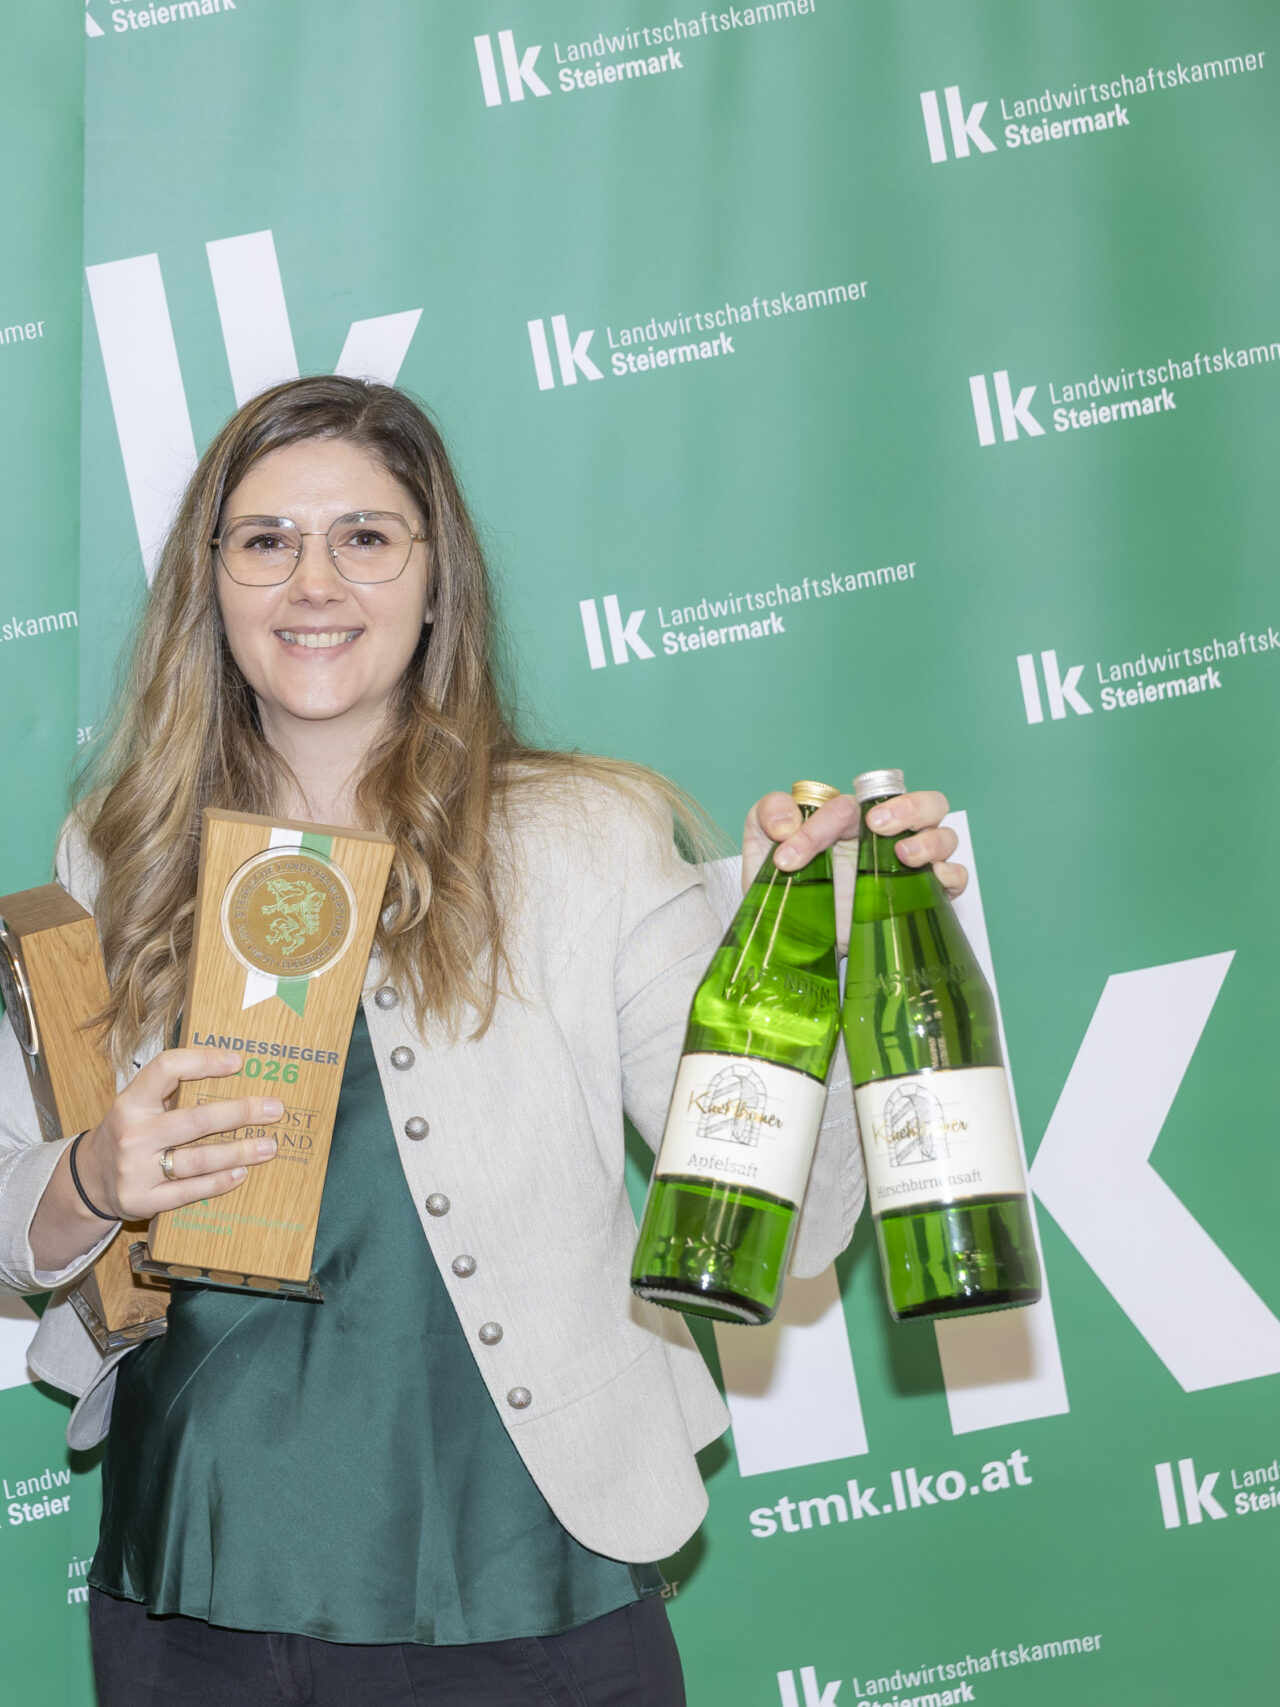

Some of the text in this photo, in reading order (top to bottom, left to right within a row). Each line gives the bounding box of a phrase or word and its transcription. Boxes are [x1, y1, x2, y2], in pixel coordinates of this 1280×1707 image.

[554, 0, 816, 64] Landwirtschaftskammer
[474, 29, 552, 107] lk
[558, 47, 683, 92] Steiermark
[1000, 50, 1266, 121] Landwirtschaftskammer
[921, 86, 997, 163] lk
[1004, 104, 1130, 149] Steiermark
[606, 280, 868, 349] Landwirtschaftskammer
[527, 315, 604, 391] lk
[611, 333, 734, 377] Steiermark
[970, 370, 1046, 446] lk
[1053, 388, 1176, 433] Steiermark
[657, 560, 917, 629] Landwirtschaftskammer
[579, 594, 655, 670] lk
[661, 613, 785, 656] Steiermark
[1017, 649, 1094, 725] lk
[1100, 666, 1222, 711] Steiermark
[193, 1032, 340, 1066] LANDESSIEGER
[235, 1057, 300, 1084] 026
[687, 1153, 759, 1179] Apfelsaft
[749, 1448, 1033, 1539] stmk.lko.at
[1155, 1457, 1228, 1530] lk
[853, 1635, 1102, 1698] Landwirtschaftskammer
